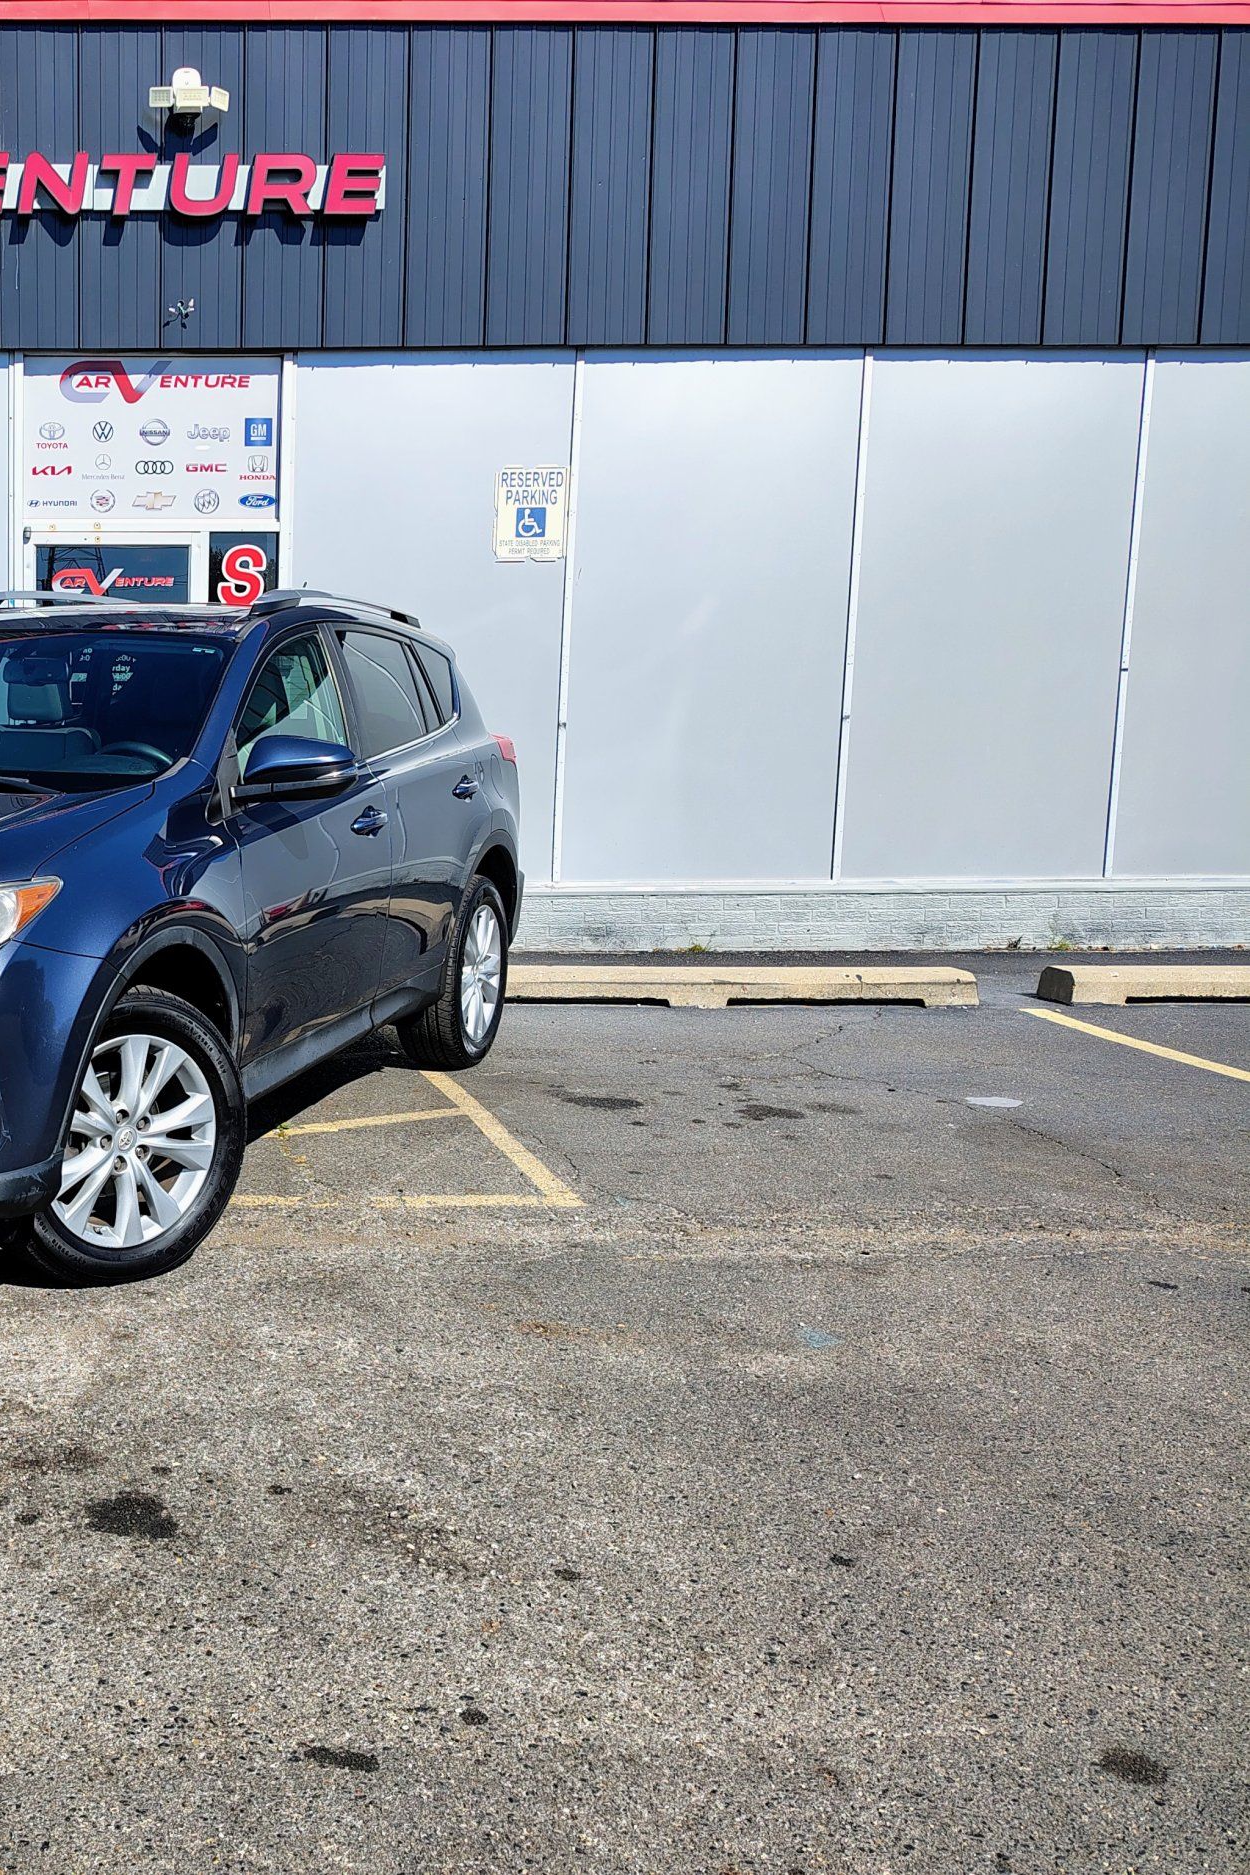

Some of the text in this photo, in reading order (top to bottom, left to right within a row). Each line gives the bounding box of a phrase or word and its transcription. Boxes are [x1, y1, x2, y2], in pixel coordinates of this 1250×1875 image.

[141, 429, 168, 437] NISSAN
[187, 424, 230, 442] Jeep
[250, 423, 267, 437] GM
[36, 442, 68, 450] TOYOTA
[185, 463, 228, 473] GMC
[501, 472, 564, 488] RESERVED
[42, 500, 78, 508] HYUNDAI
[245, 495, 270, 507] Ford
[505, 489, 558, 506] PARKING
[217, 544, 266, 606] S
